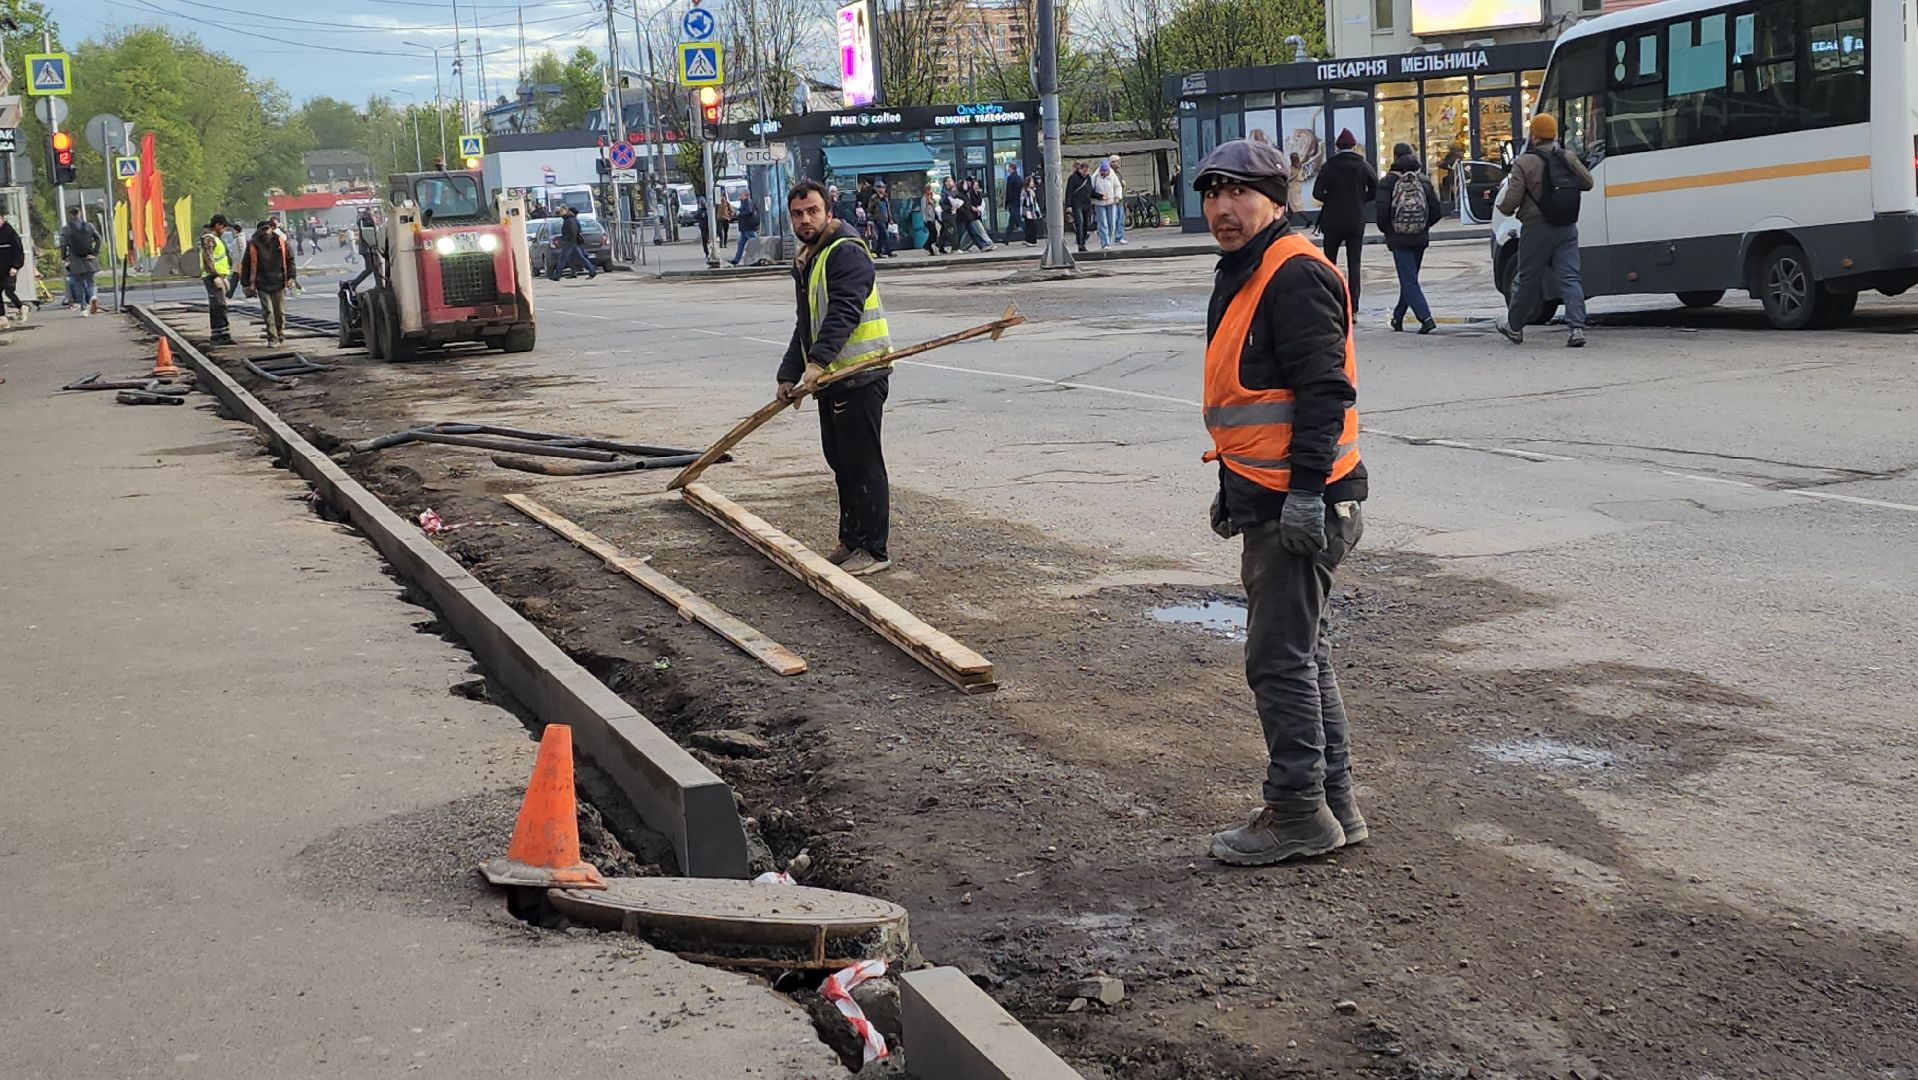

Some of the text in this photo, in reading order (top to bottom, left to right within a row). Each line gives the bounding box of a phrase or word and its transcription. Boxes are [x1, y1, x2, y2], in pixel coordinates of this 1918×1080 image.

[1317, 50, 1489, 81] ПЕКАРНЯ МЕЛЬНИЦА
[745, 151, 772, 162] СТО
